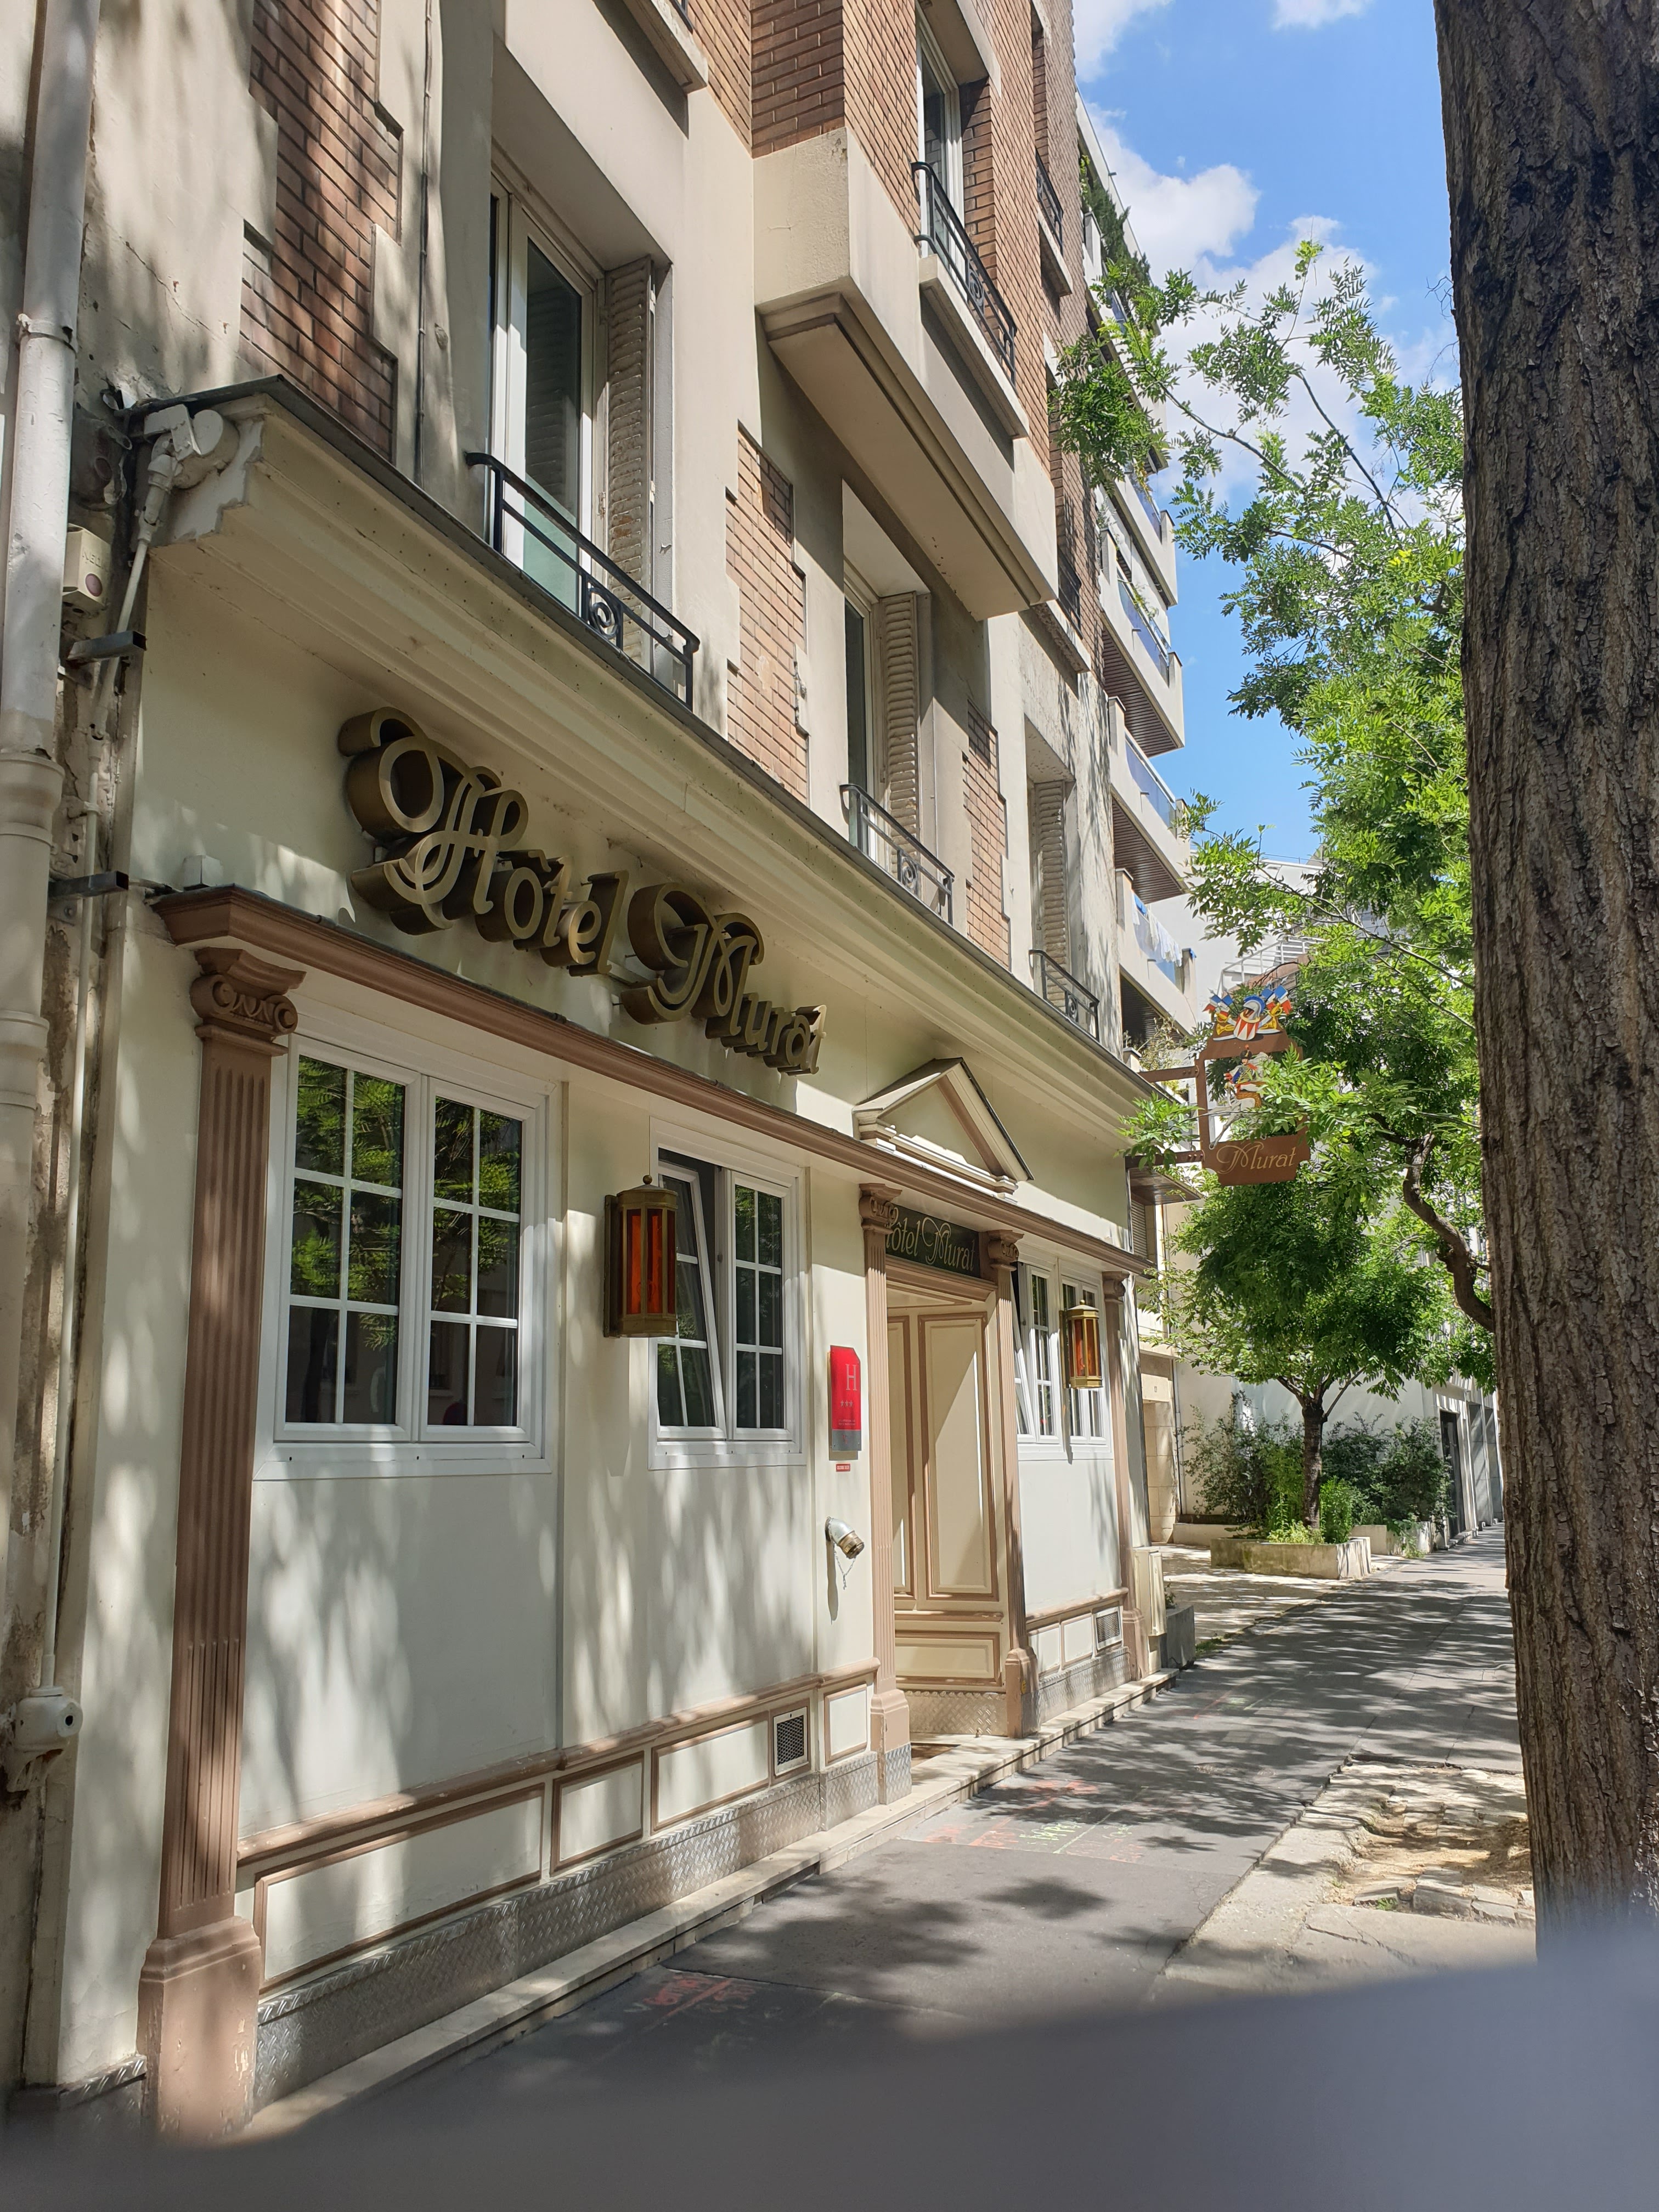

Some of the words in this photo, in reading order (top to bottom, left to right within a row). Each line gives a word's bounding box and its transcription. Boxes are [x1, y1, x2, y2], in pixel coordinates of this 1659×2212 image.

[346, 706, 629, 974] Hôtel
[628, 882, 827, 1075] Murat
[1216, 1142, 1296, 1174] Murat
[922, 1217, 975, 1271] Murat
[845, 1364, 857, 1391] H
